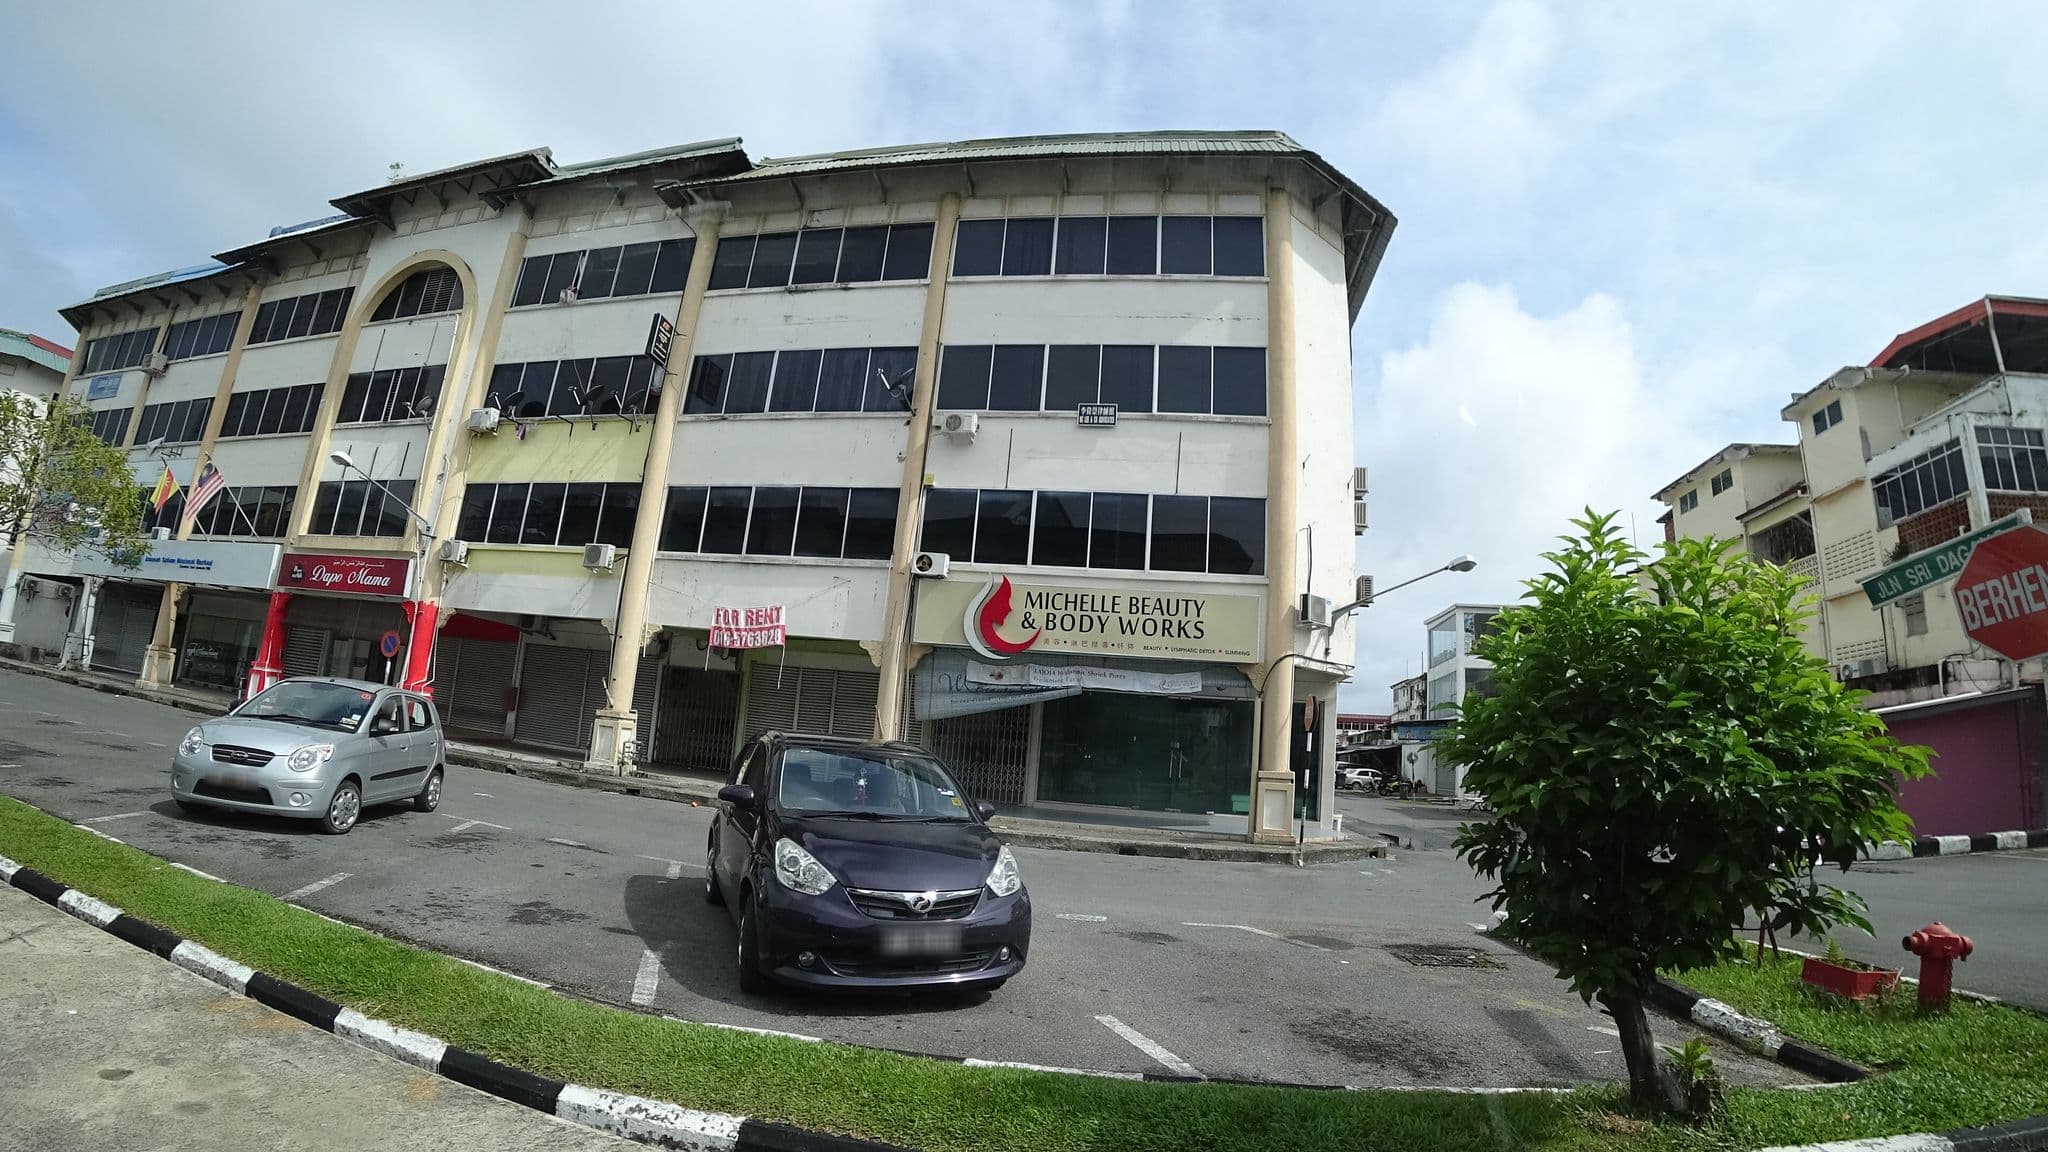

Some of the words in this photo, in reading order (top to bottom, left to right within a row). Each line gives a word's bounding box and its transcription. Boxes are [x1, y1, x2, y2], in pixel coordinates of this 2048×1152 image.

[310, 564, 343, 587] Dapo
[347, 567, 391, 586] Mama
[1878, 575, 1903, 599] JLN
[1905, 562, 1933, 586] SRI
[716, 607, 740, 626] FOR
[745, 605, 782, 627] RENT
[1024, 591, 1121, 614] MICHELLE
[1128, 596, 1206, 618] BEAUTY
[1021, 611, 1037, 630] &
[1045, 612, 1109, 634] BODY
[1118, 616, 1205, 640] WORKS
